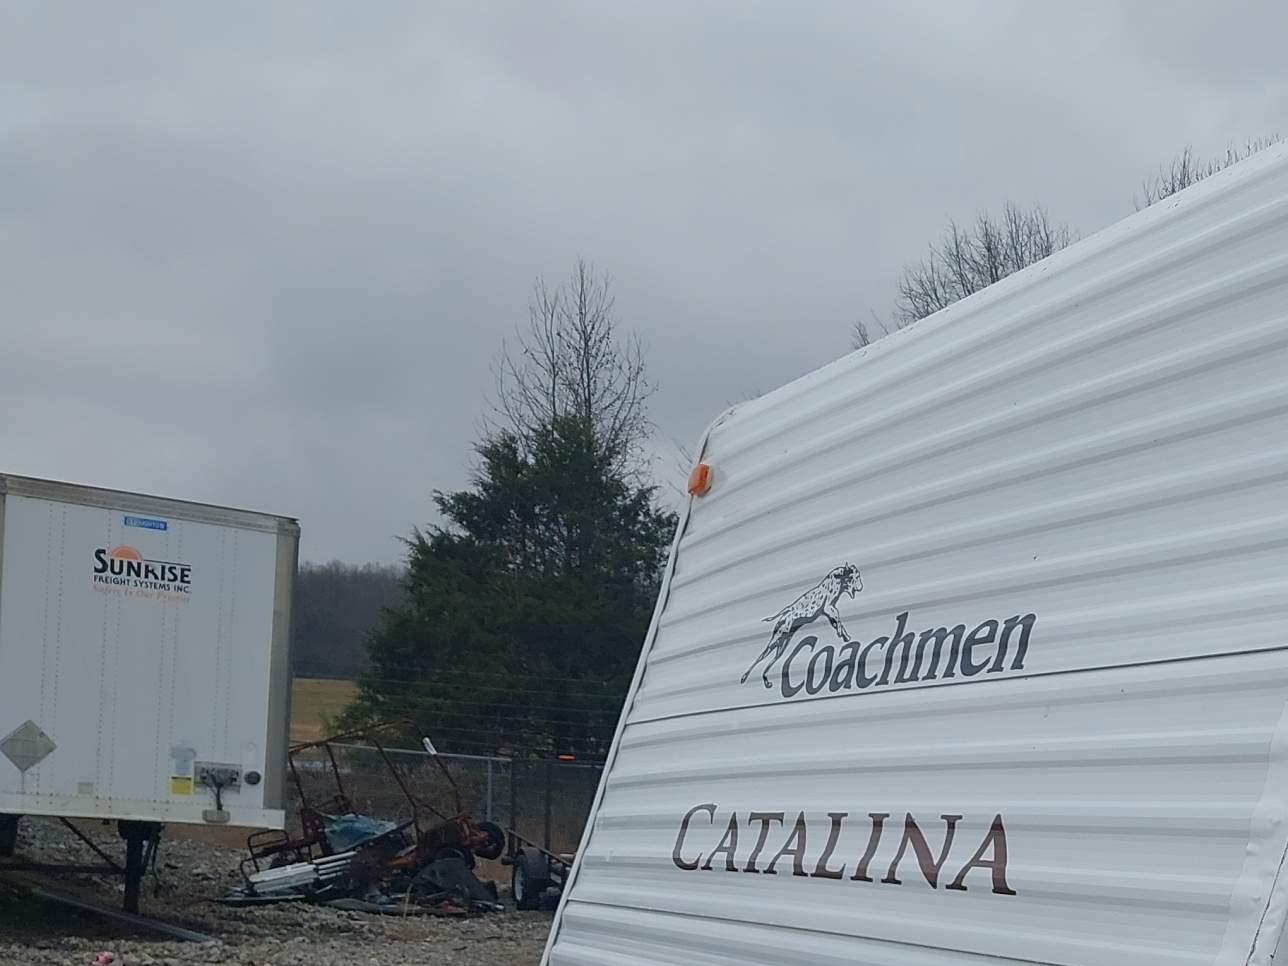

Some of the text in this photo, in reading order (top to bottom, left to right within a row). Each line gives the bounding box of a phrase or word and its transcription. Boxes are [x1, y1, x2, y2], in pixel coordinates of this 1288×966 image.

[94, 548, 191, 585] SUNRISE
[133, 579, 171, 591] SYSTEMS
[781, 611, 1037, 698] Coachmen
[672, 803, 1018, 896] CATALINA
